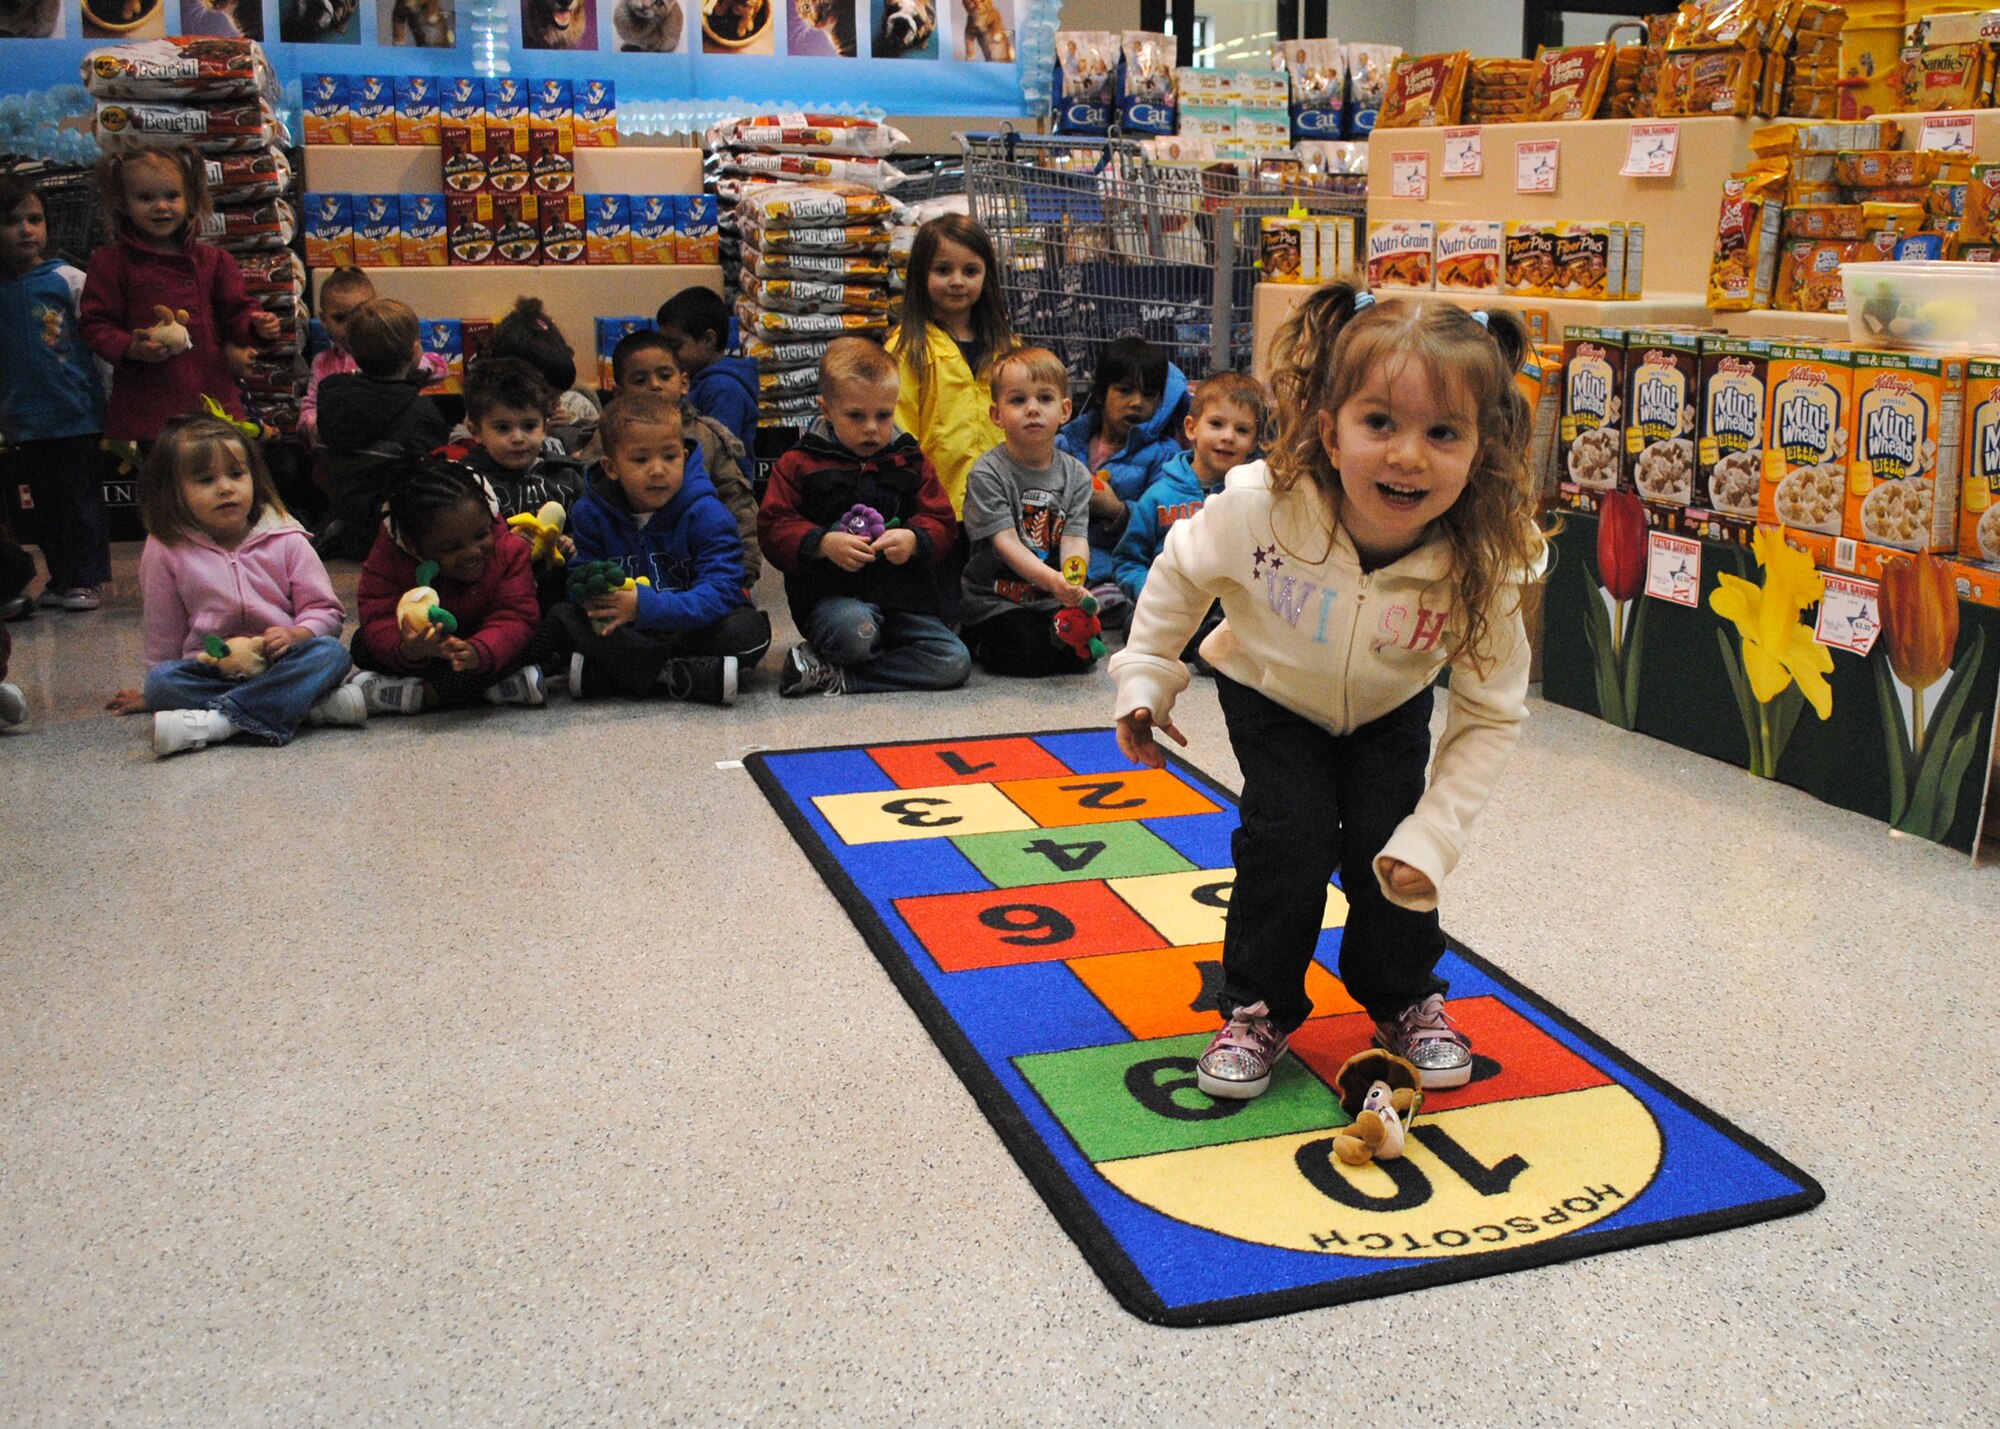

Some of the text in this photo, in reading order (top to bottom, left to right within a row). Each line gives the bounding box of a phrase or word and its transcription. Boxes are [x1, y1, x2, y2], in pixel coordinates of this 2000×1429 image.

[137, 60, 198, 78] Beneful
[1918, 54, 1963, 72] Sandies
[314, 104, 338, 116] Busy
[360, 104, 384, 116] Busy
[405, 105, 430, 117] Busy
[451, 106, 475, 118] Busy
[496, 106, 519, 118] Busy
[540, 107, 563, 119] Busy
[584, 108, 607, 120] Busy
[1068, 104, 1104, 125] Cat
[1128, 104, 1168, 125] Cat
[144, 111, 206, 132] Beneful
[1297, 110, 1336, 130] Cat
[793, 199, 845, 216] Beneful
[316, 225, 341, 238] Busy
[364, 225, 389, 238] Busy
[411, 225, 436, 238] Busy
[597, 224, 620, 237] Busy
[641, 224, 664, 237] Busy
[685, 224, 708, 237] Busy
[793, 227, 845, 243] Beneful
[1371, 234, 1428, 256] Nutri Grain
[1440, 235, 1497, 257] Nutri Grain
[792, 256, 843, 270] Beneful
[794, 284, 842, 300] Beneful
[791, 316, 841, 331] Beneful
[779, 343, 827, 360] Benefu
[1719, 356, 1755, 379] Kellogg's
[1788, 365, 1828, 387] Kellogg's
[1873, 372, 1914, 397] Kellogg's
[1573, 395, 1605, 416] Wheats
[1640, 404, 1677, 429] Wheats
[1715, 414, 1755, 437] Wheats
[1644, 422, 1671, 441] Little
[1782, 425, 1827, 451] Wheats
[1718, 434, 1748, 451] Little
[1868, 433, 1914, 463] Wheats
[1786, 446, 1819, 465] Little
[1872, 458, 1905, 480] Little
[1653, 538, 1696, 555] EXTRA SAVINGS
[1825, 579, 1848, 593] EXTRA
[1264, 569, 1449, 654] WISH
[936, 750, 997, 777] 1
[1059, 781, 1147, 810] 2
[881, 798, 963, 827] 3
[1022, 838, 1106, 872] 4
[1295, 1124, 1531, 1212] 10
[1310, 1184, 1625, 1251] HOPSCOTCH
